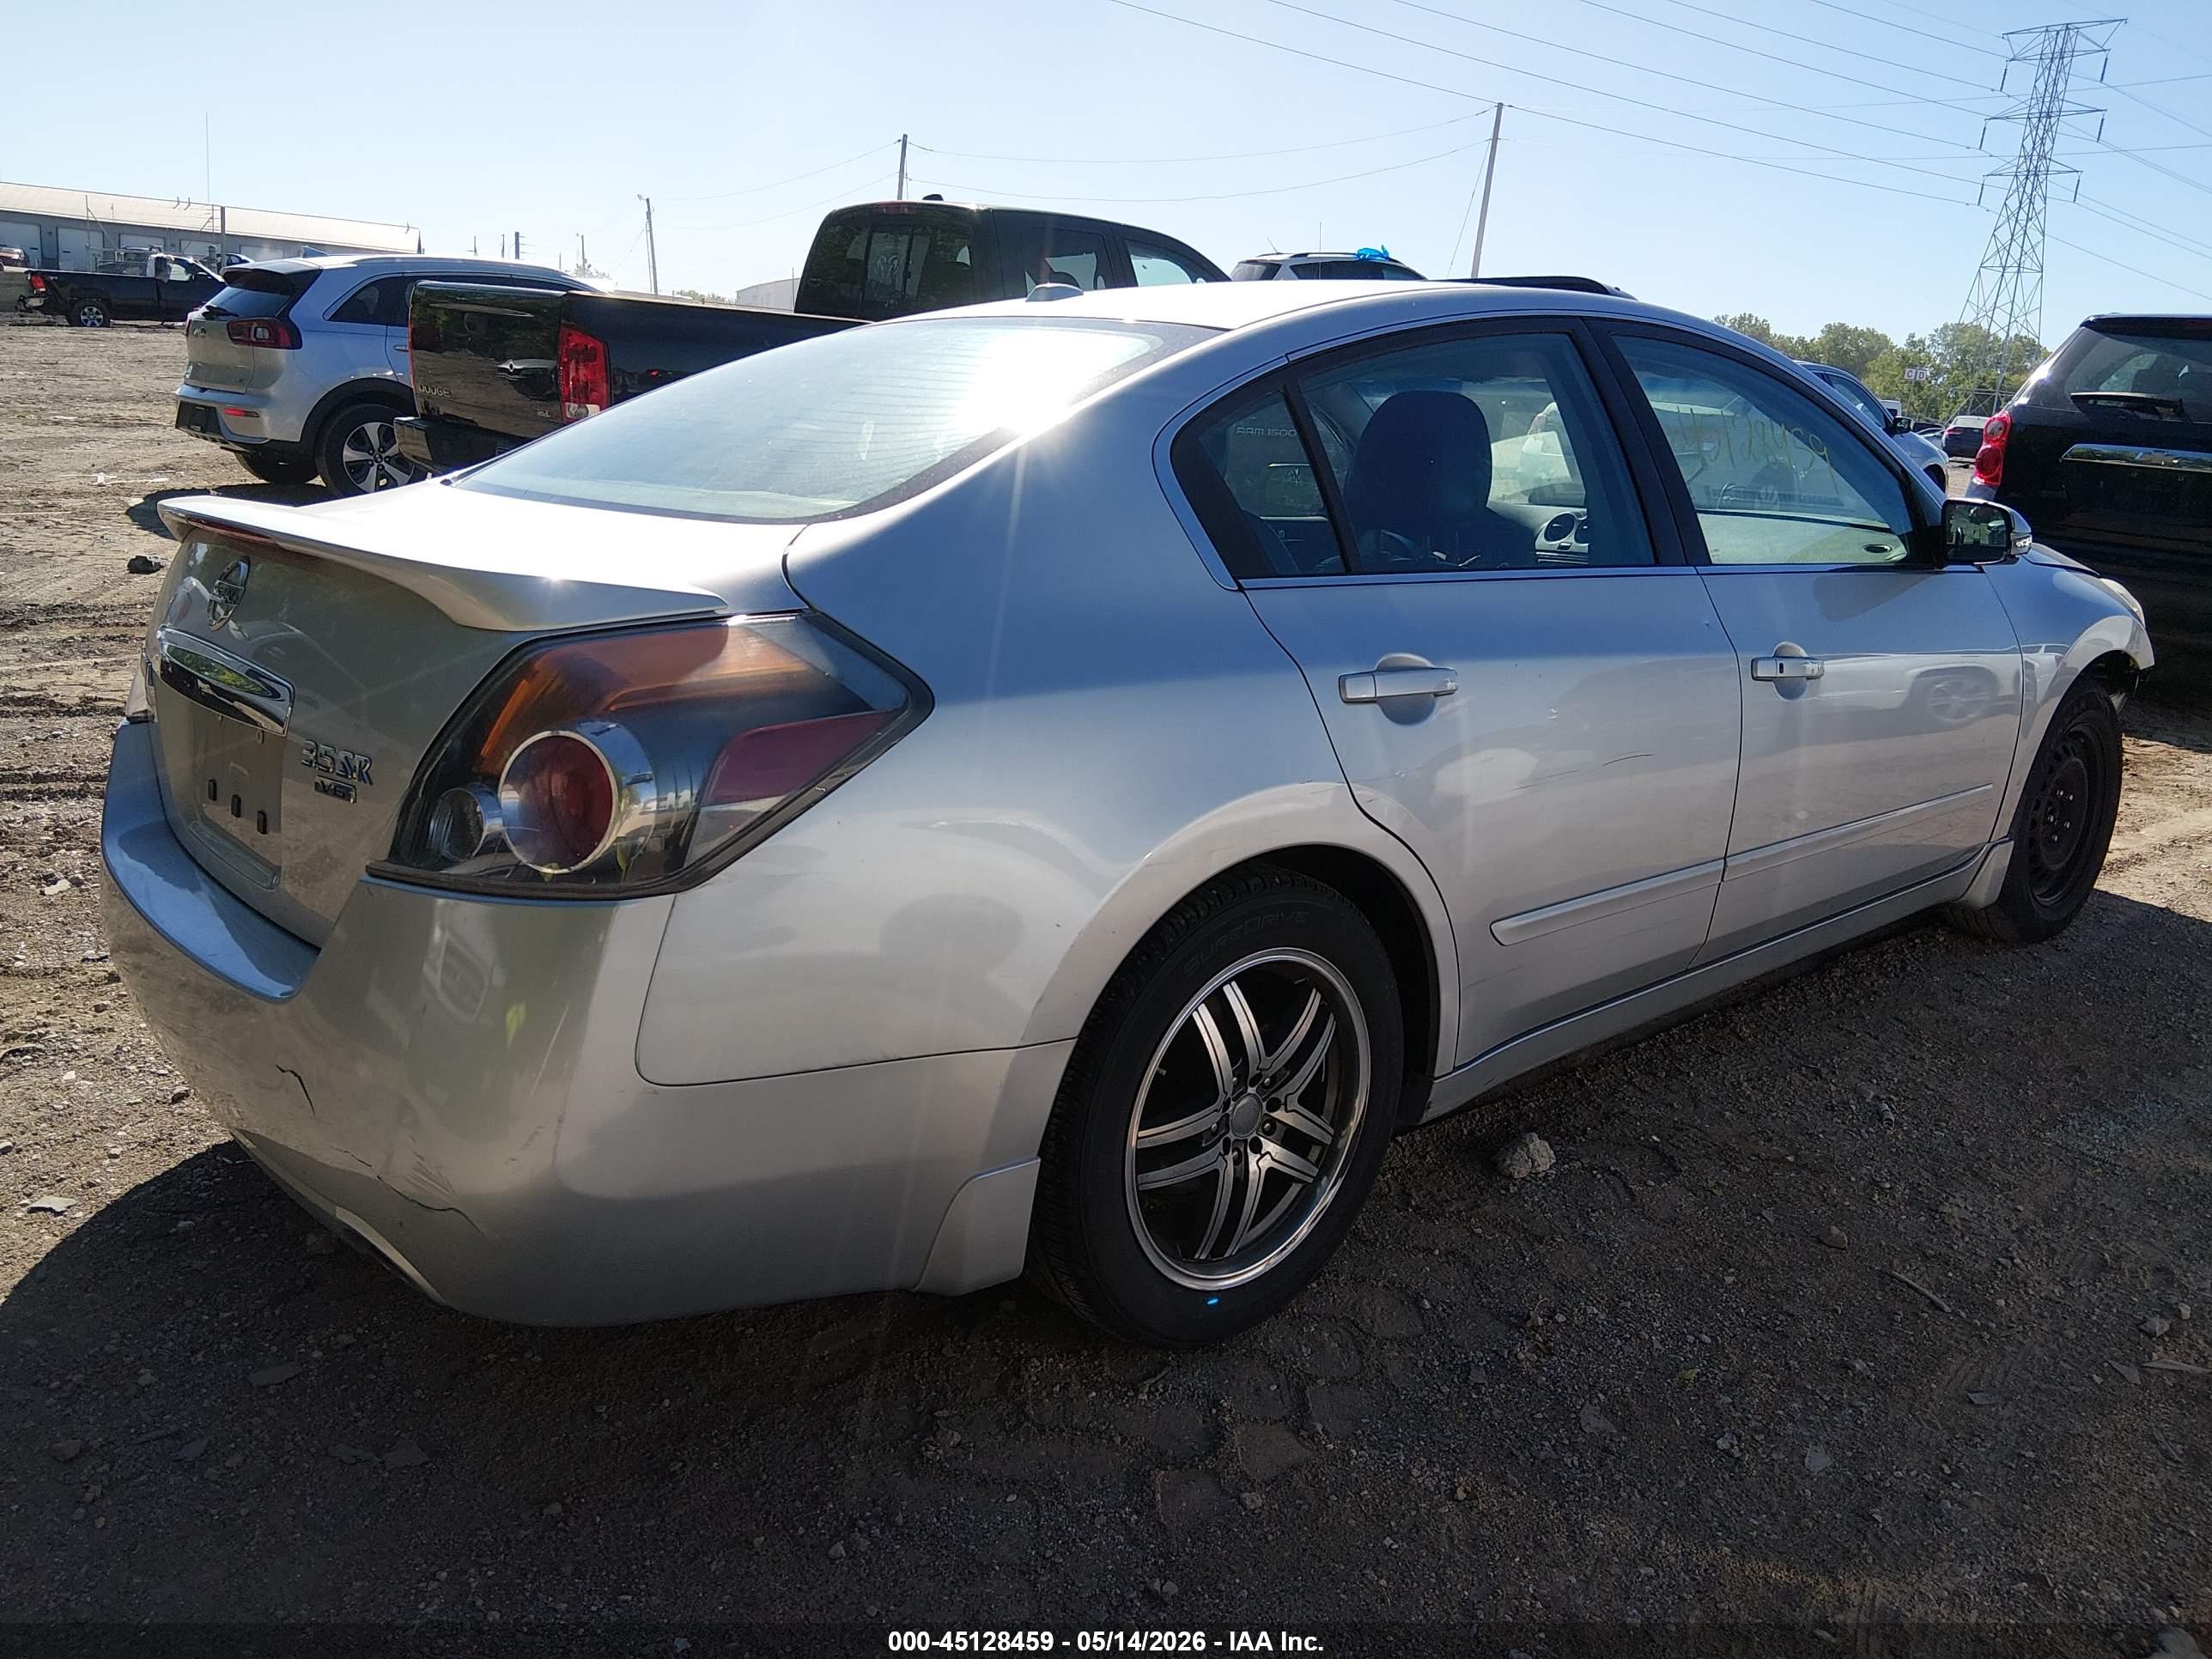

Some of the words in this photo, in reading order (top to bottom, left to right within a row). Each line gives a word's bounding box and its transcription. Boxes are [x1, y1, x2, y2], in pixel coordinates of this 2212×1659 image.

[1918, 371, 1924, 380] D
[418, 384, 451, 398] DODGE
[1236, 427, 1265, 436] RAM
[1267, 428, 1298, 437] 1500
